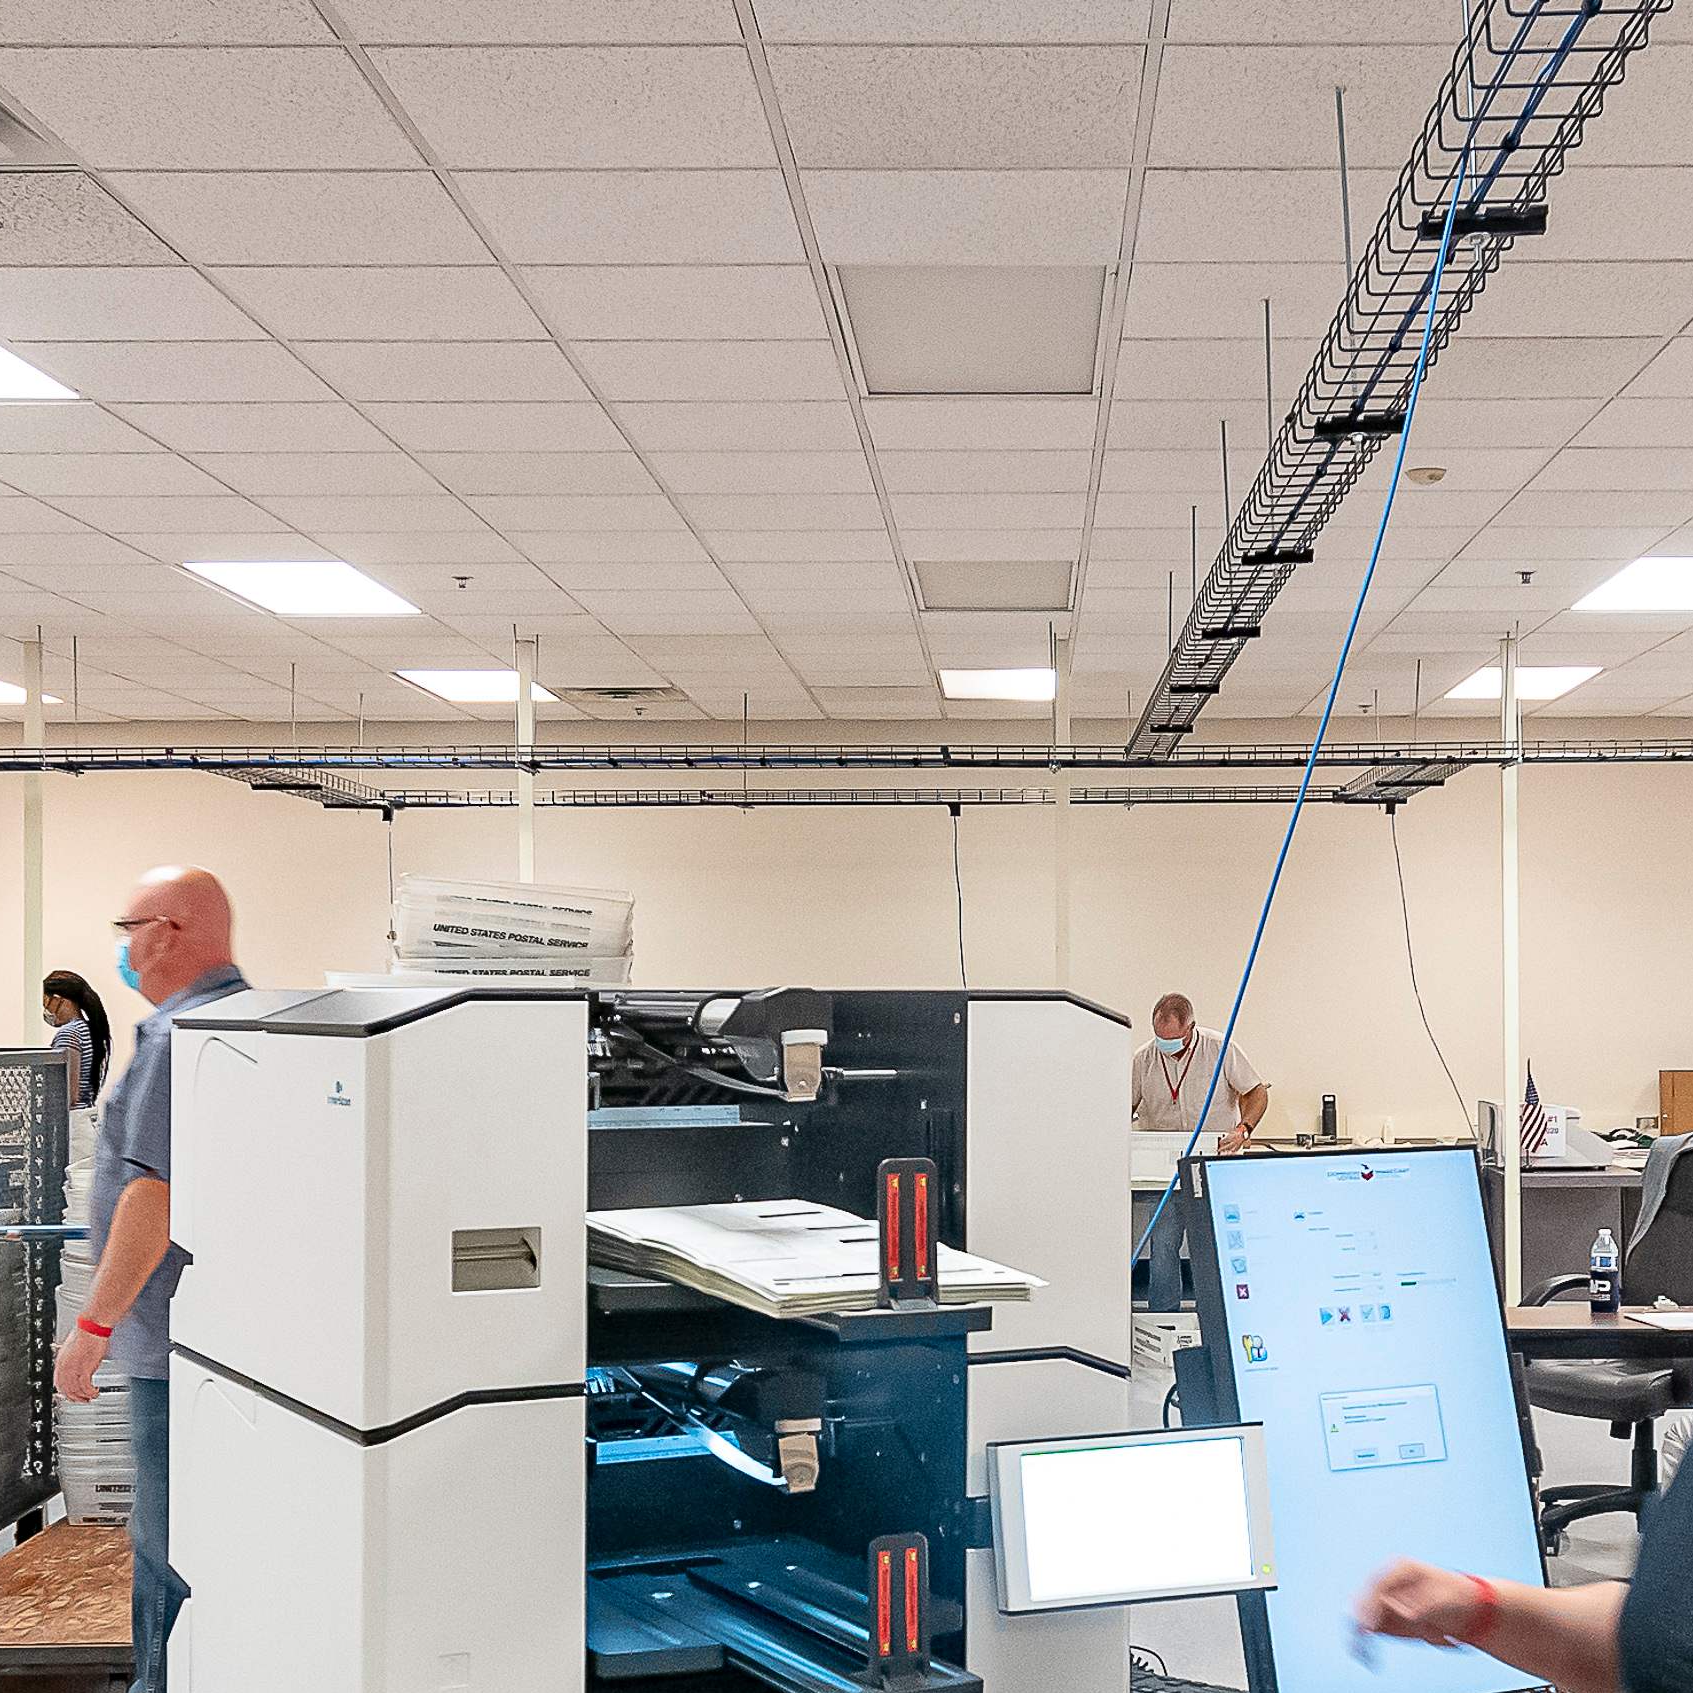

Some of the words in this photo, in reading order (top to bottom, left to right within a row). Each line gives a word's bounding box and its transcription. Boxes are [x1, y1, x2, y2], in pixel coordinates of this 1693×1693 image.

[433, 923, 469, 935] UNITED
[470, 928, 506, 940] STATES
[507, 933, 545, 945] POSTAL
[549, 968, 591, 977] SERVICE
